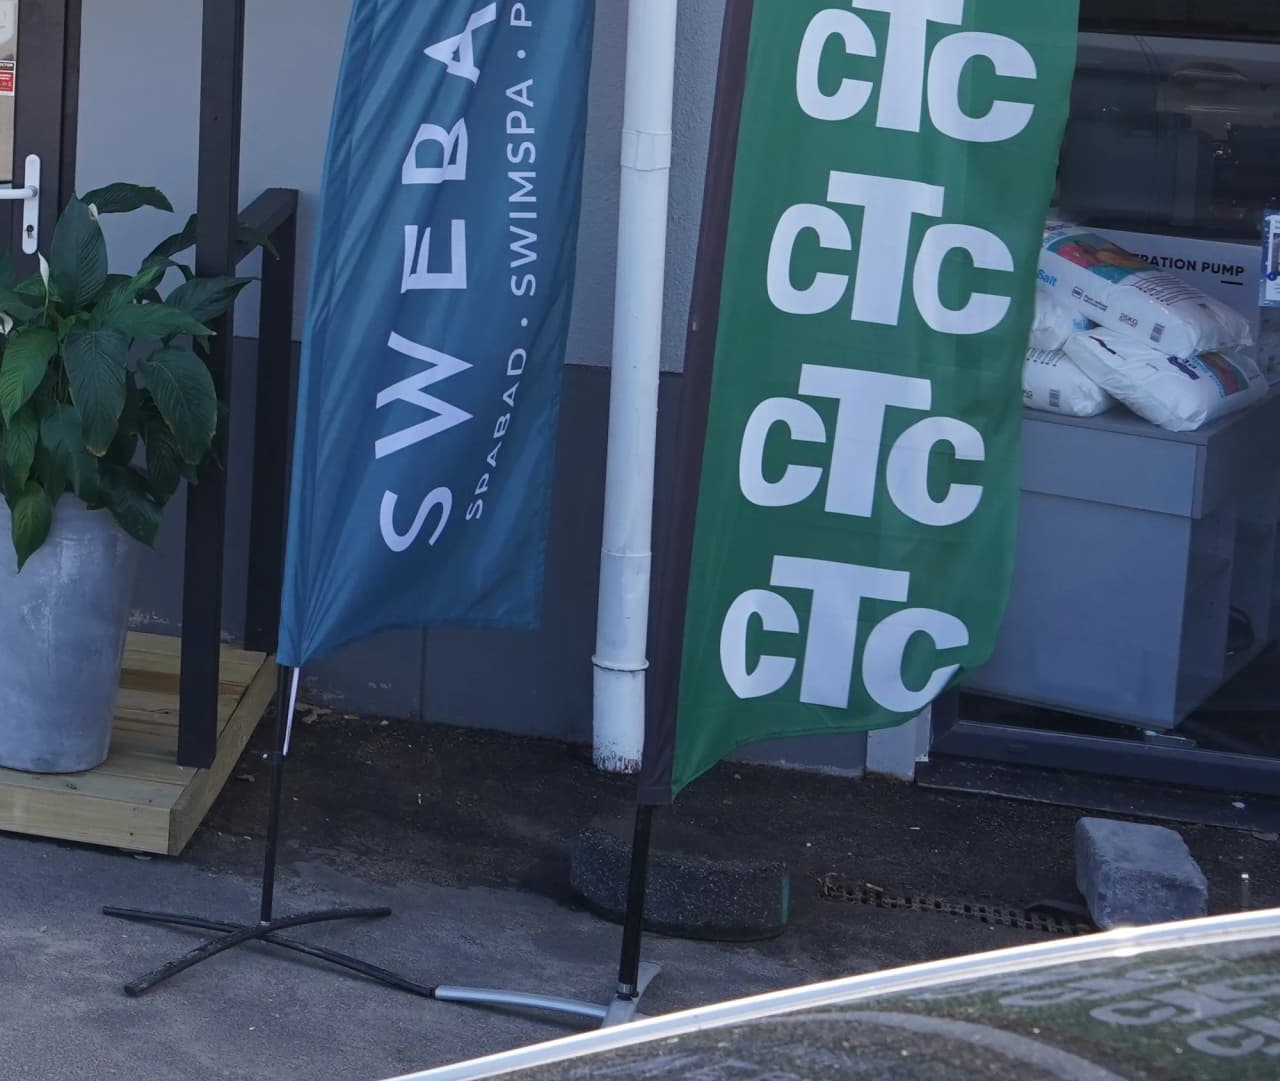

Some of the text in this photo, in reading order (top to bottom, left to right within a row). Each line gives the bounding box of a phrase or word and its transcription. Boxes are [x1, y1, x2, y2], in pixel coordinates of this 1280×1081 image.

[465, 347, 527, 520] SPABAD
[505, 77, 537, 297] SWIMSPA
[765, 169, 1014, 335] CTC
[1201, 261, 1245, 277] PUMP
[738, 362, 986, 526] CTC
[719, 554, 969, 713] CTC
